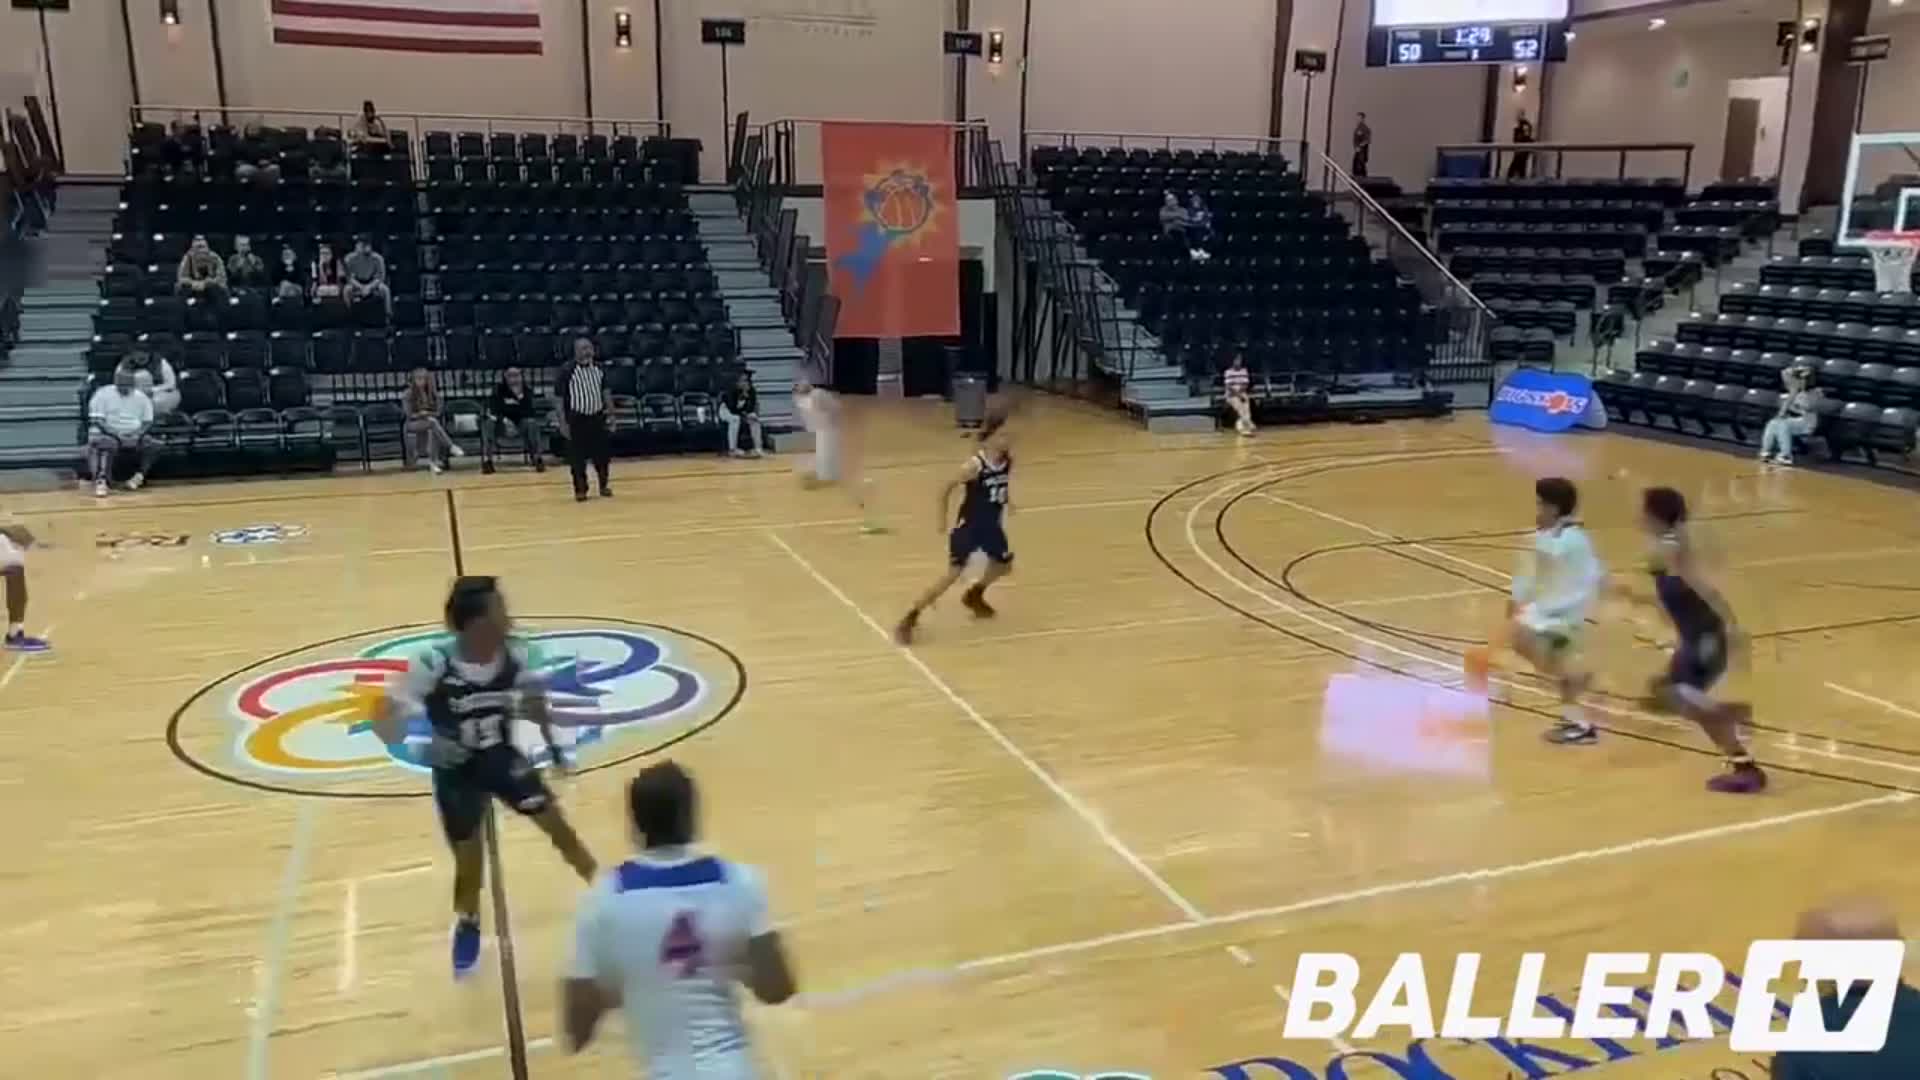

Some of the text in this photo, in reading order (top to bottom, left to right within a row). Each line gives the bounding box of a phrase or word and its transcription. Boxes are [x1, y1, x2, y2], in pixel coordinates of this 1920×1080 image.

[1397, 43, 1422, 61] 50
[1513, 38, 1538, 59] 52
[660, 909, 704, 978] 4
